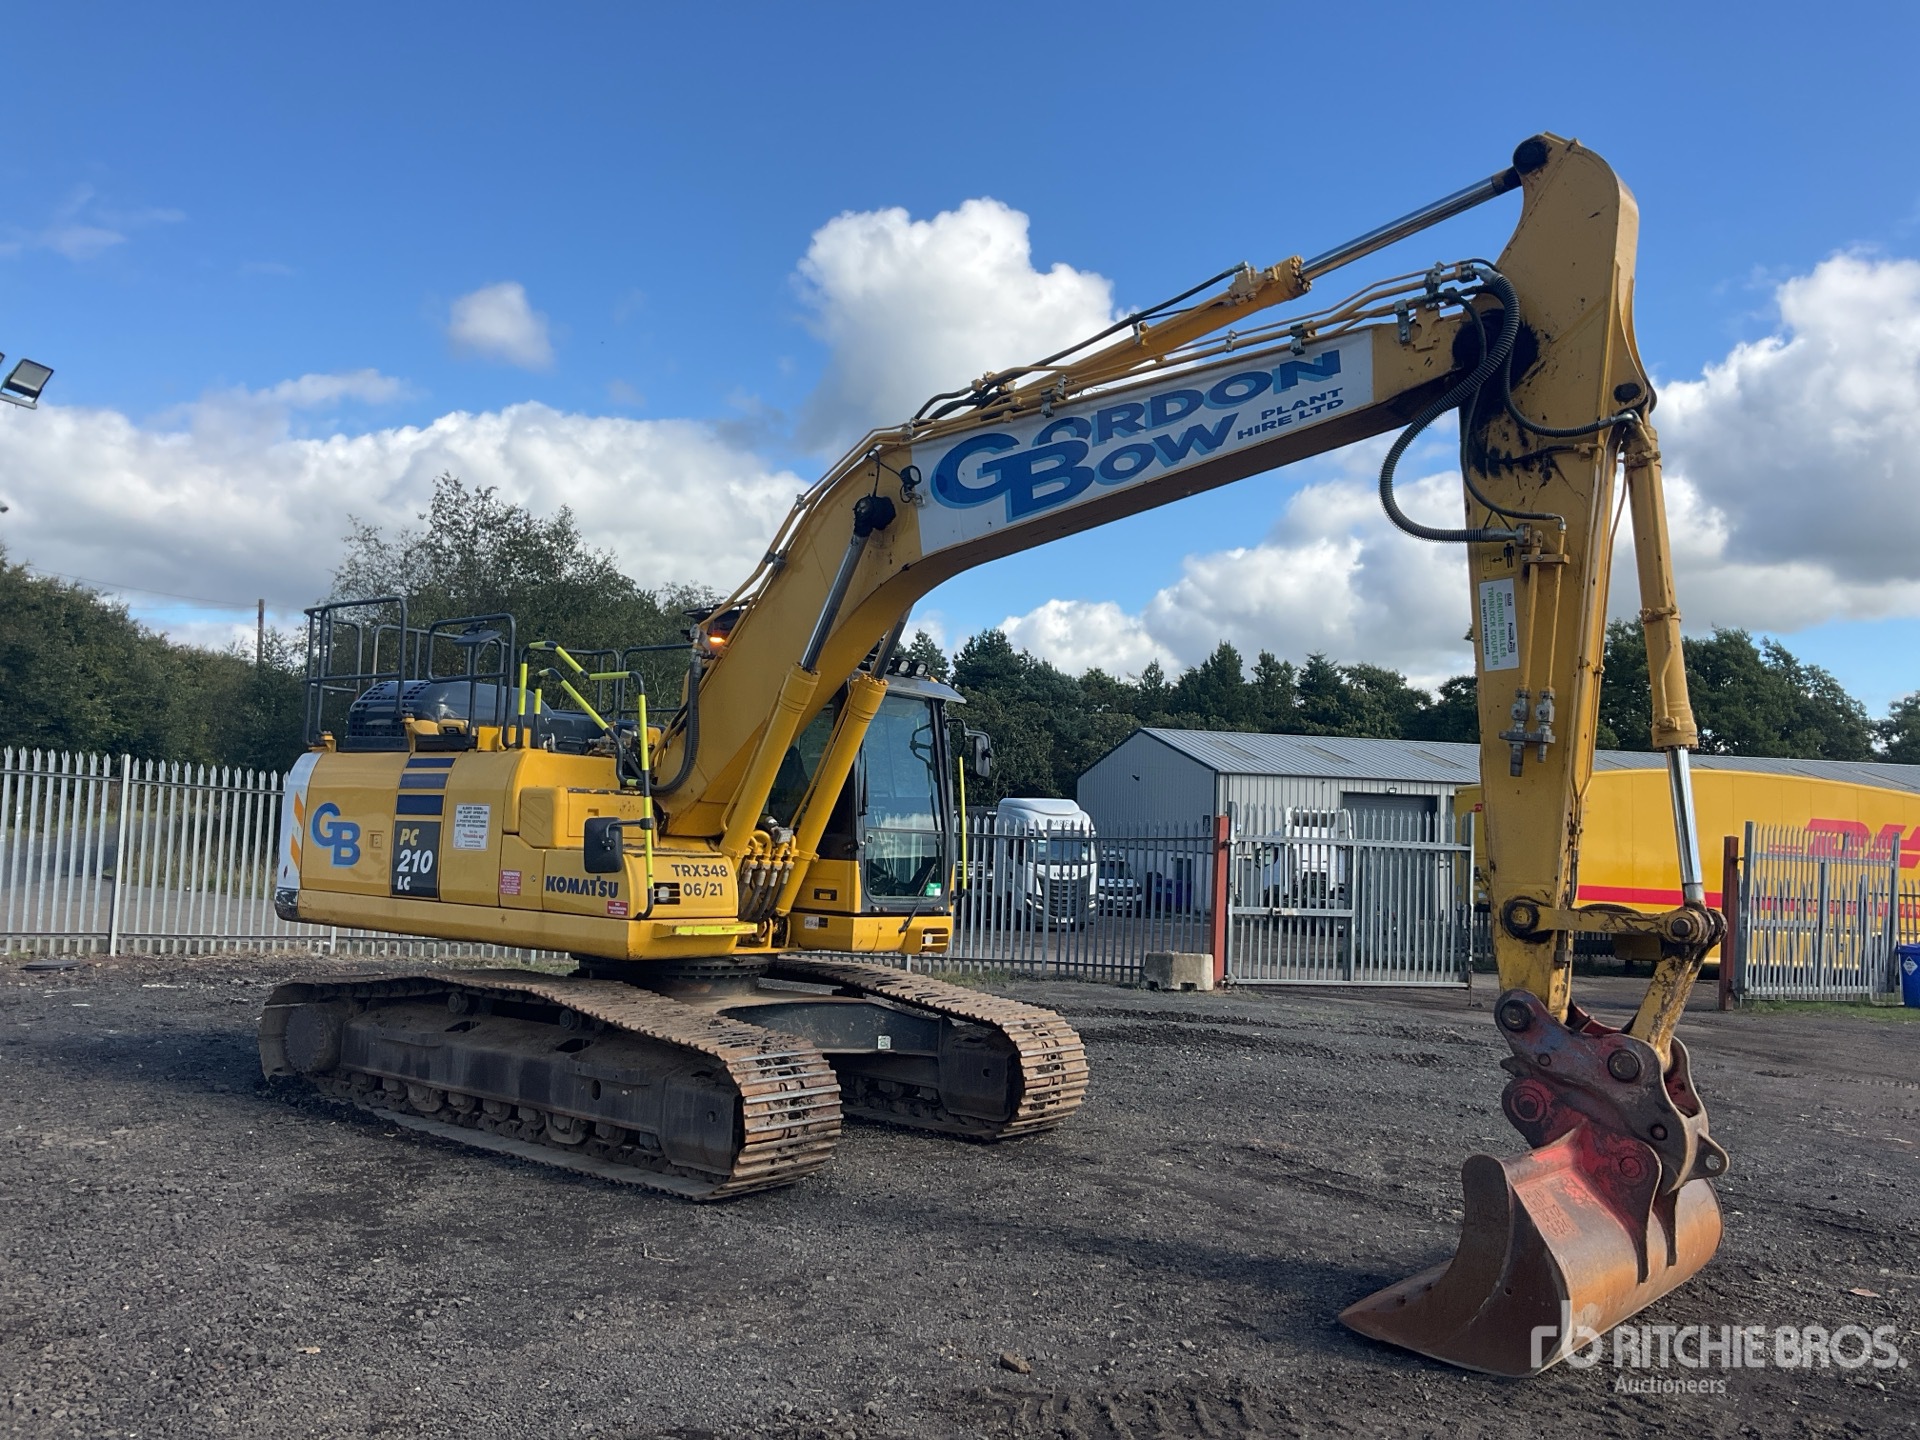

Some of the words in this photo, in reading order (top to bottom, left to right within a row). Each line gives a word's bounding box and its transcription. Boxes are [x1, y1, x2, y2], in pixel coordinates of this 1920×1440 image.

[1237, 416, 1293, 440] HIRE
[1298, 398, 1344, 423] LTD
[1261, 387, 1343, 421] PLANT
[930, 350, 1342, 510] GORDON
[1006, 412, 1239, 523] BOW
[1487, 586, 1496, 628] TWINLOCK
[1496, 591, 1505, 628] GENUINE
[1490, 629, 1499, 666] COUPLER
[1498, 629, 1507, 658] MILLER
[310, 802, 361, 868] GB
[399, 828, 420, 847] PC
[397, 849, 434, 874] 210
[671, 864, 728, 877] TRX348
[397, 875, 411, 891] LC
[545, 875, 618, 898] KOMATSU
[683, 881, 723, 898] 06/21
